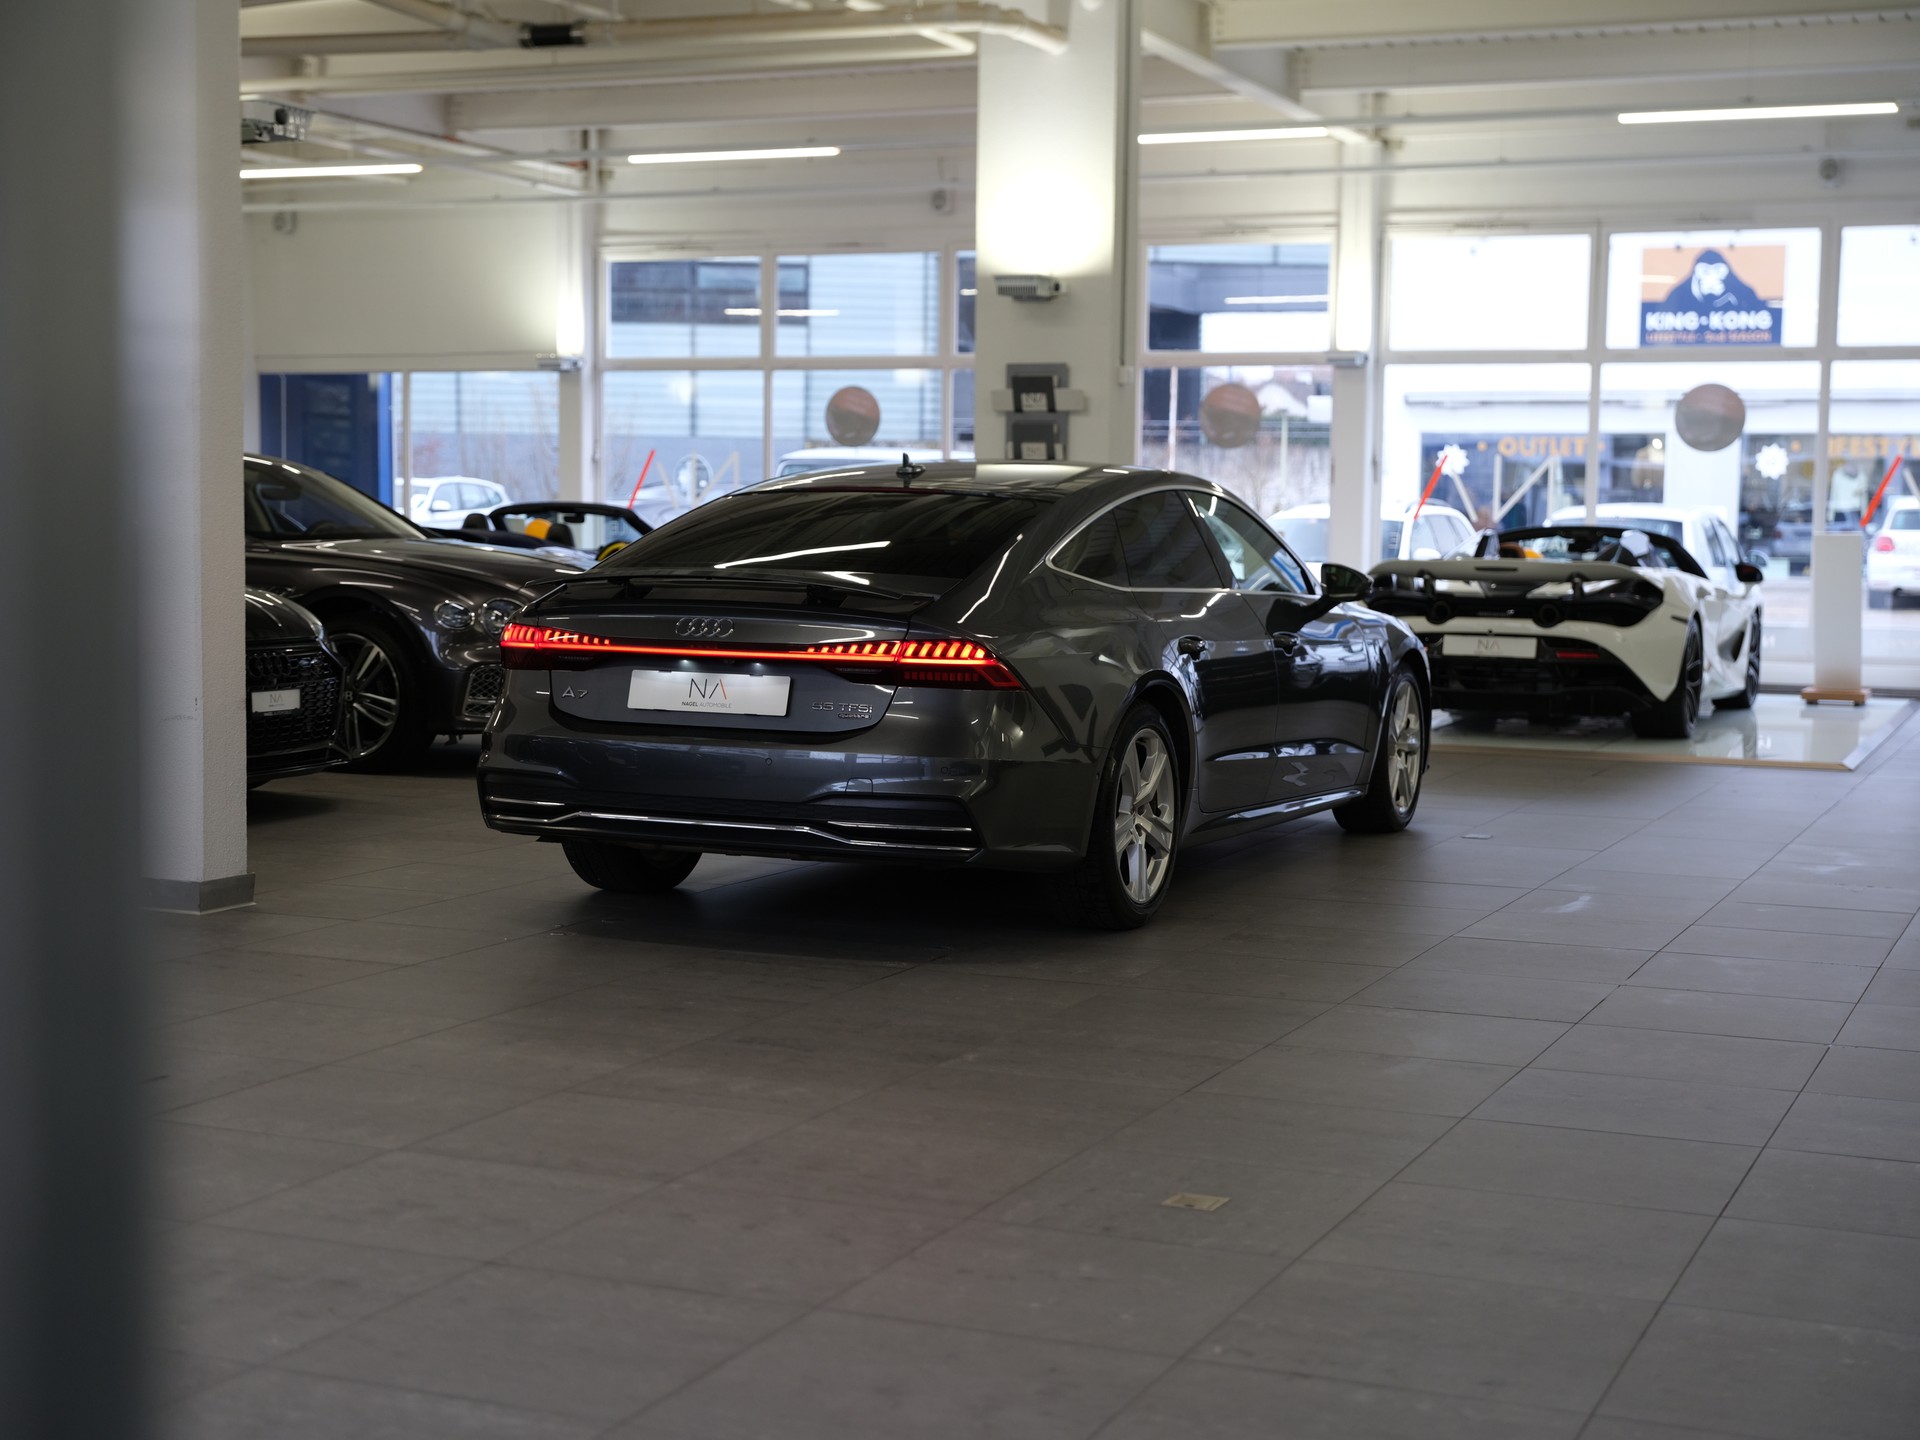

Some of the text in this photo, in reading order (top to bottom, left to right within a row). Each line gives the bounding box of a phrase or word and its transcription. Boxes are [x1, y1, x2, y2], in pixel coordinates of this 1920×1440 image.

[1645, 310, 1773, 330] KING KONG
[1497, 435, 1588, 457] OUTLET
[562, 686, 588, 698] A7
[689, 678, 727, 700] NA
